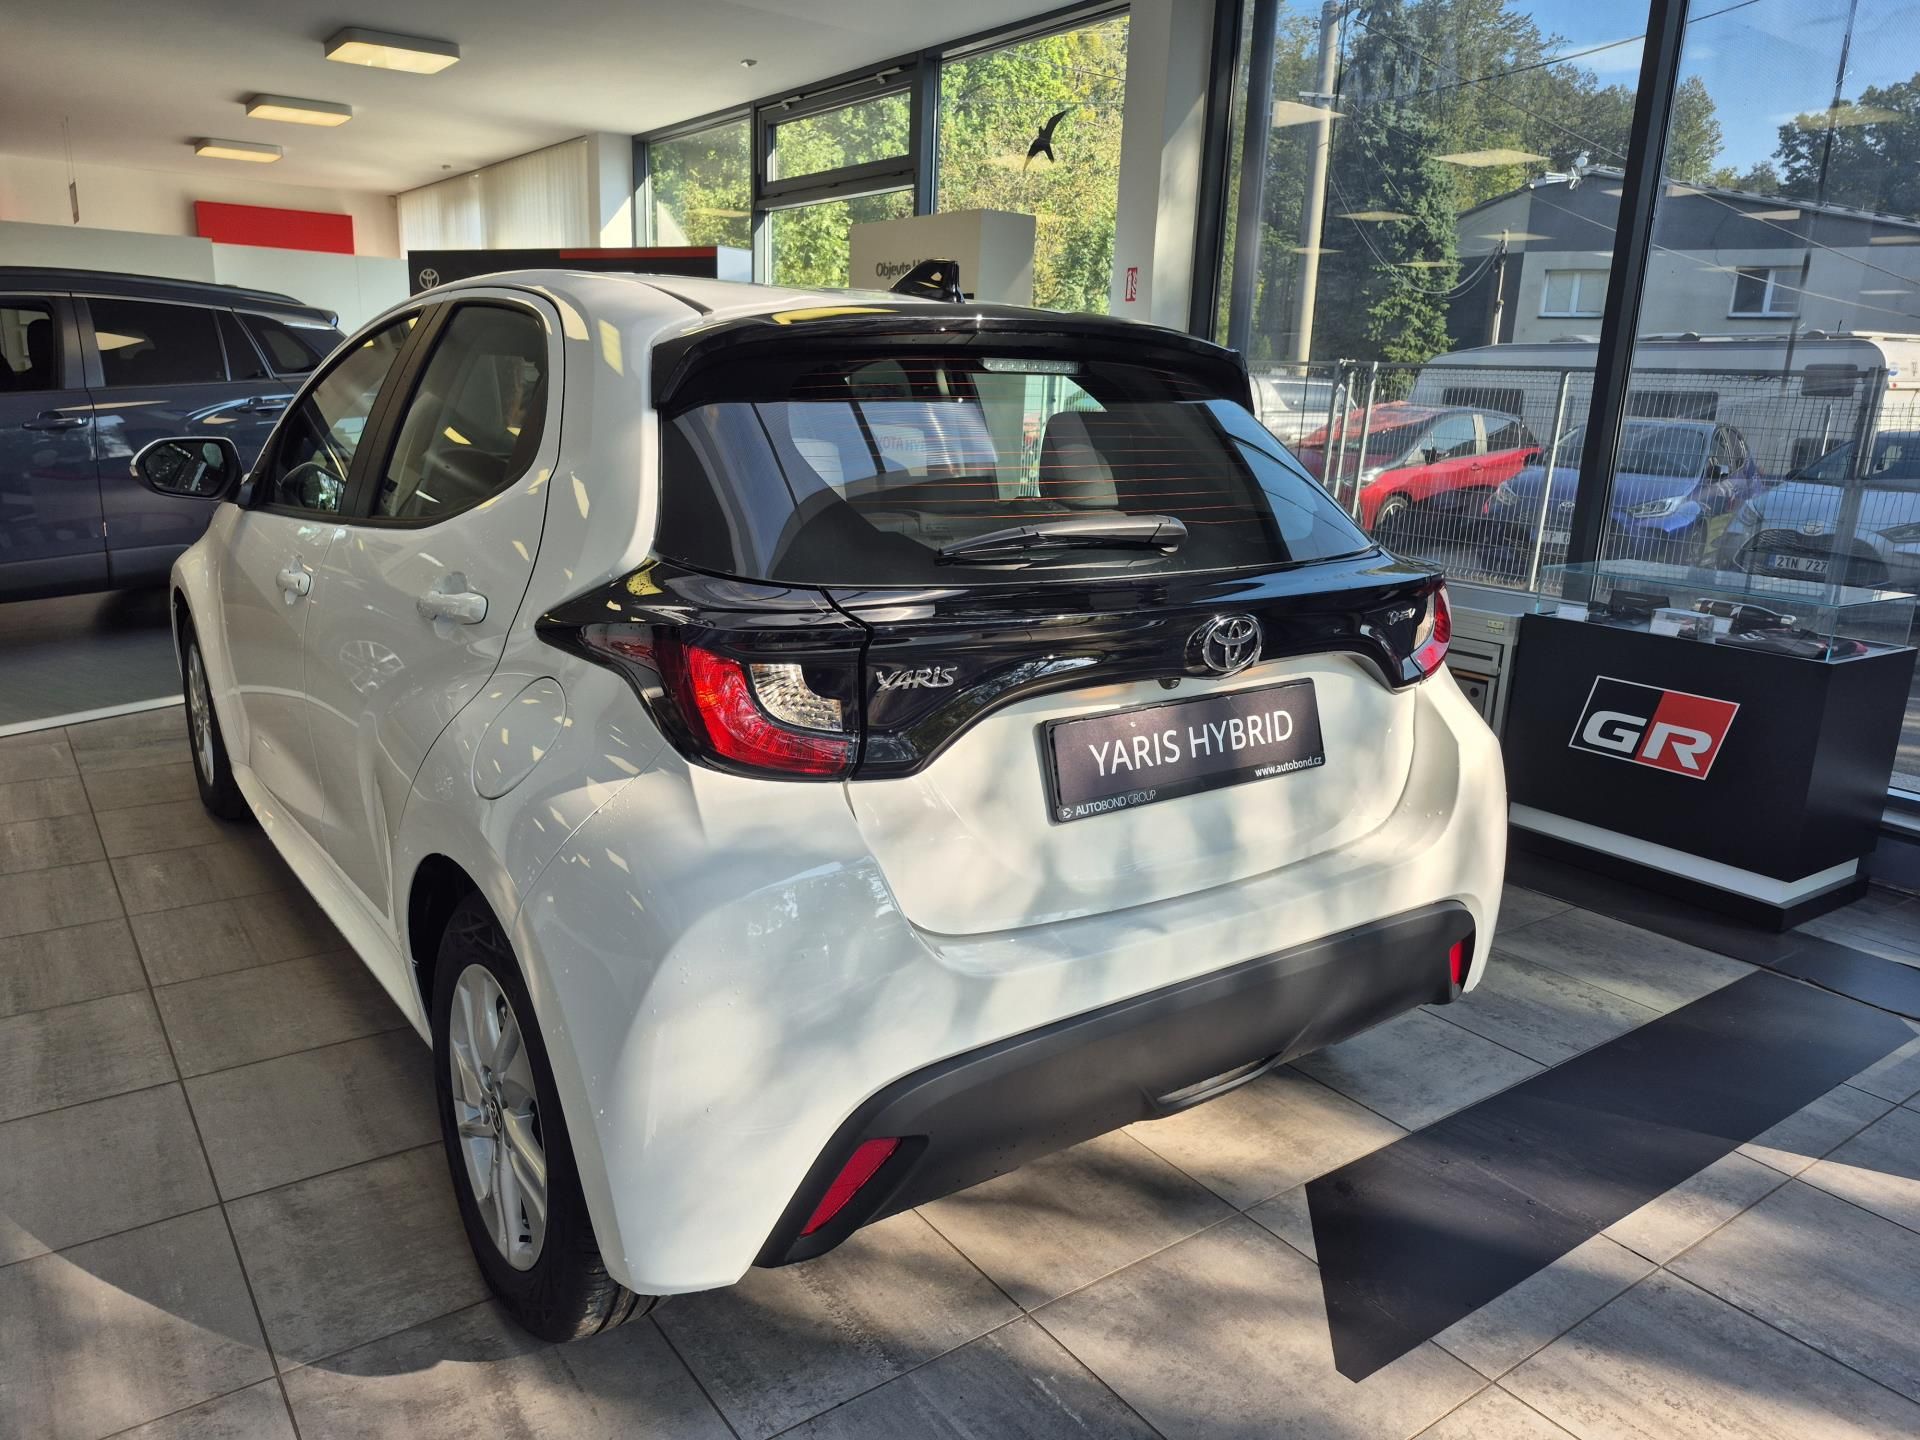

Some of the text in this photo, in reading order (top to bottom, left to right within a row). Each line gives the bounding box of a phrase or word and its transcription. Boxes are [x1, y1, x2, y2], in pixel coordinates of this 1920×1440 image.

[1805, 559, 1828, 573] 727
[1089, 710, 1294, 777] YARIS HYBRID
[1582, 710, 1713, 771] GR
[1254, 755, 1323, 778] www.autobond.cz
[1075, 789, 1157, 817] AUTOBOND GROUP
